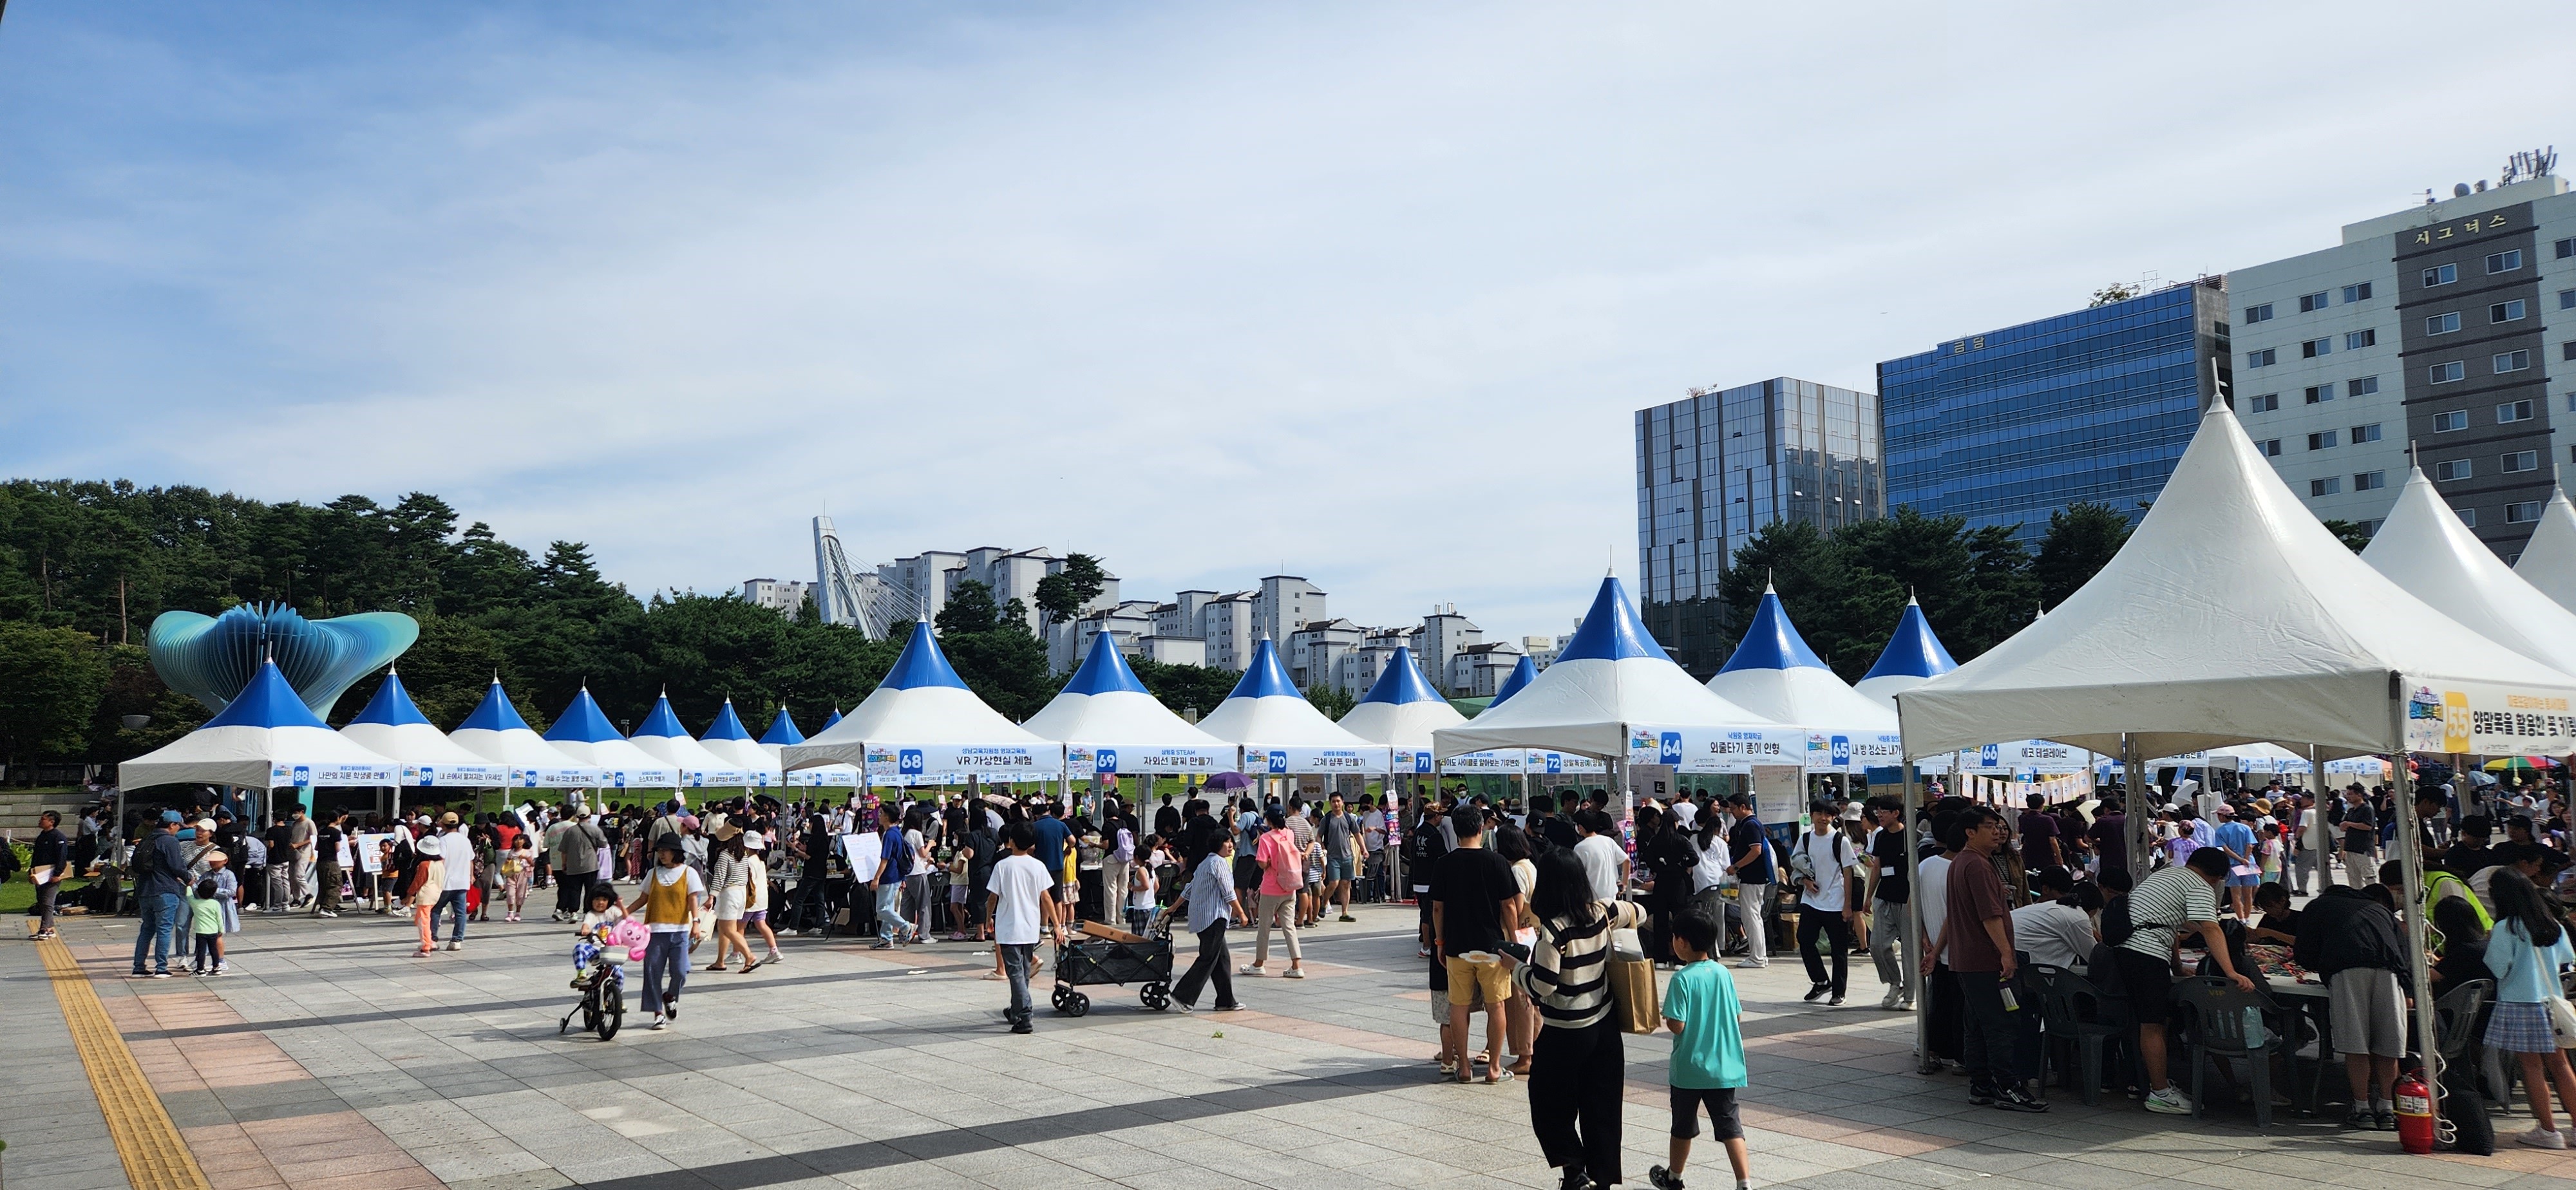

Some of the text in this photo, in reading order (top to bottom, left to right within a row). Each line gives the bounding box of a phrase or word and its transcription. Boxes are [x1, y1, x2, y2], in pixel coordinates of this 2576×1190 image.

[2448, 706, 2469, 738] 55
[2473, 711, 2514, 735] 양말목을
[2515, 712, 2545, 737] 활용한
[1662, 739, 1681, 757] 64
[1710, 741, 1780, 755] 외줄타기 종이 인형
[1833, 742, 1849, 759] 65
[1852, 744, 1859, 755] 내
[1861, 744, 1867, 756] 방
[1868, 743, 1888, 756] 청소는
[2021, 747, 2067, 759] 에코 테셀레이션
[956, 755, 1032, 766] VR 가상현실 체험
[1983, 749, 1998, 760] 66
[901, 754, 922, 769] 68
[1097, 754, 1116, 768] 69
[1143, 756, 1213, 766] 자외선 팔찌 만들기
[1271, 755, 1286, 768] 70
[1312, 757, 1366, 767] 고체 샴푸 만들기
[1418, 756, 1428, 768] 71
[1457, 758, 1478, 767] 사이클로
[1479, 759, 1500, 767] 알아보는
[1548, 758, 1560, 769] 72
[295, 770, 308, 782] 88
[318, 771, 338, 780] 나만의
[421, 771, 433, 782] 89
[526, 773, 536, 784] 90
[616, 775, 623, 784] 91
[695, 775, 702, 784] 92
